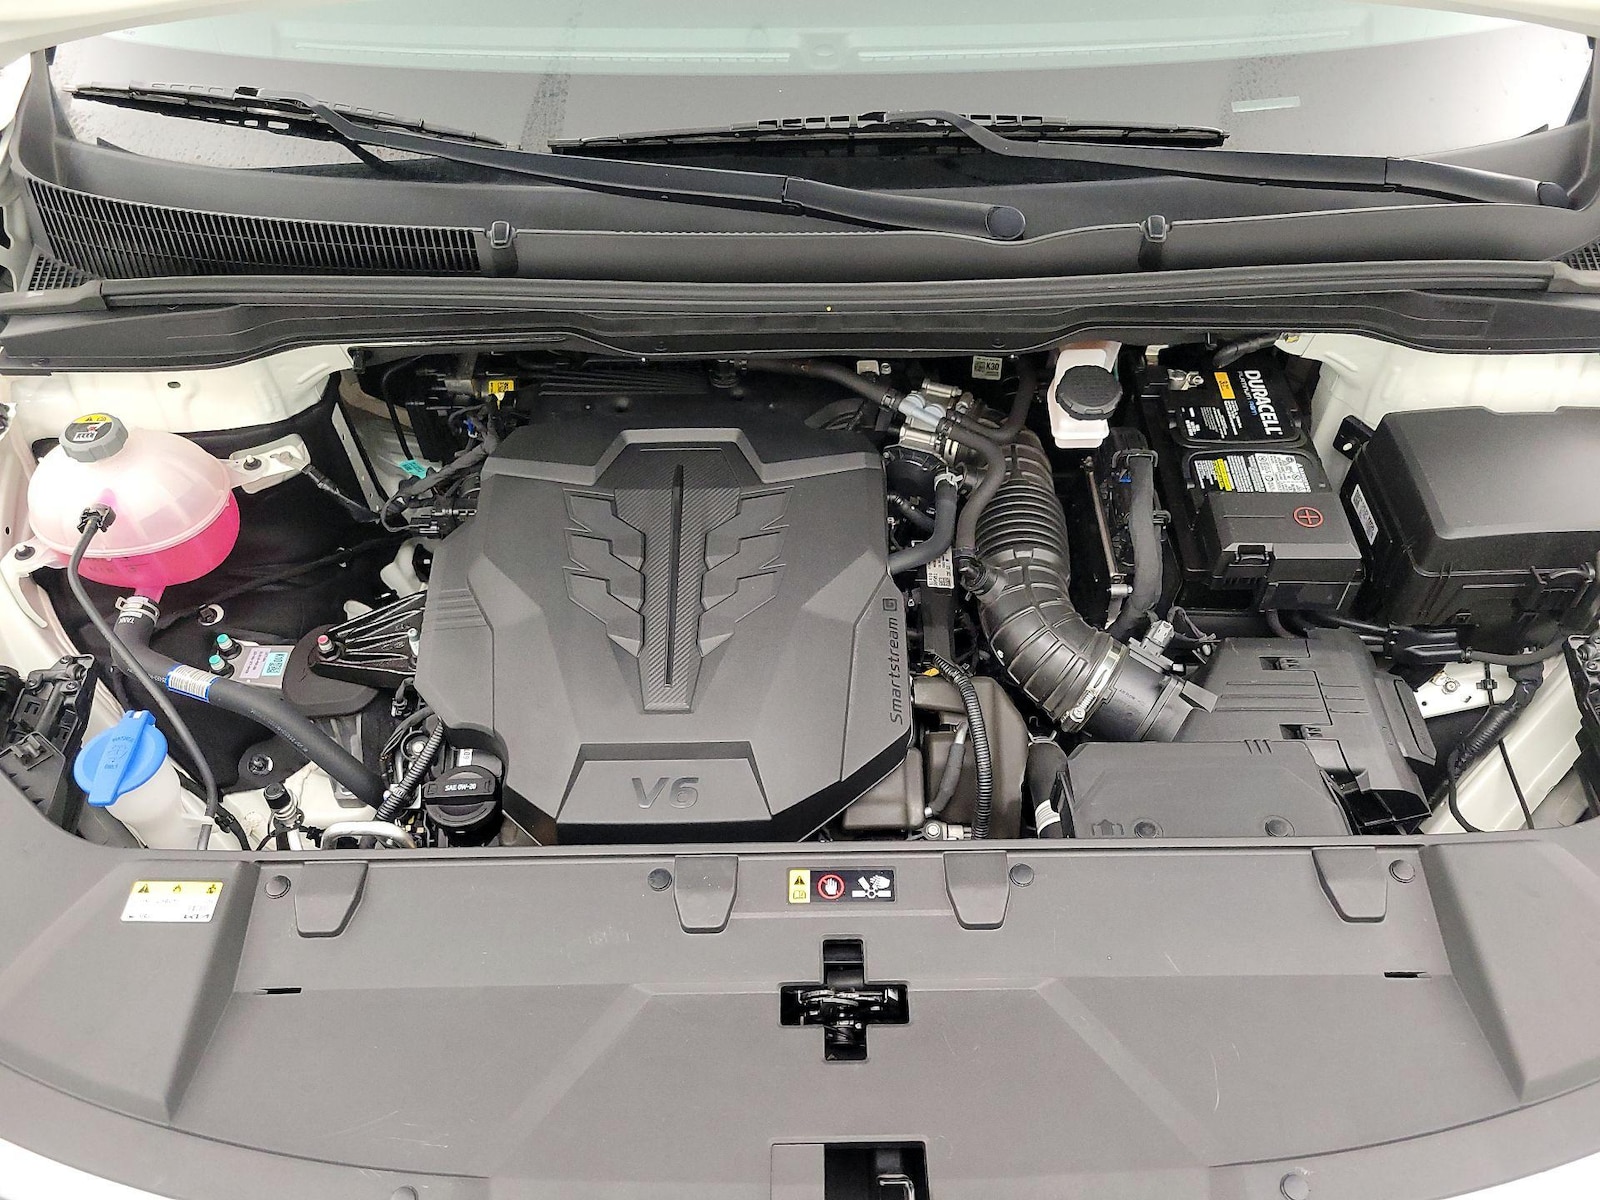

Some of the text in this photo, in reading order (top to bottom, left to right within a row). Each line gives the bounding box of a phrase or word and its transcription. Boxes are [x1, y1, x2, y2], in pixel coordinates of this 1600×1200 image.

[986, 361, 1000, 371] K30
[1244, 370, 1283, 435] DURACELL
[888, 617, 902, 725] Smartstream
[444, 783, 477, 792] SAE 0W-20
[631, 777, 699, 809] V6
